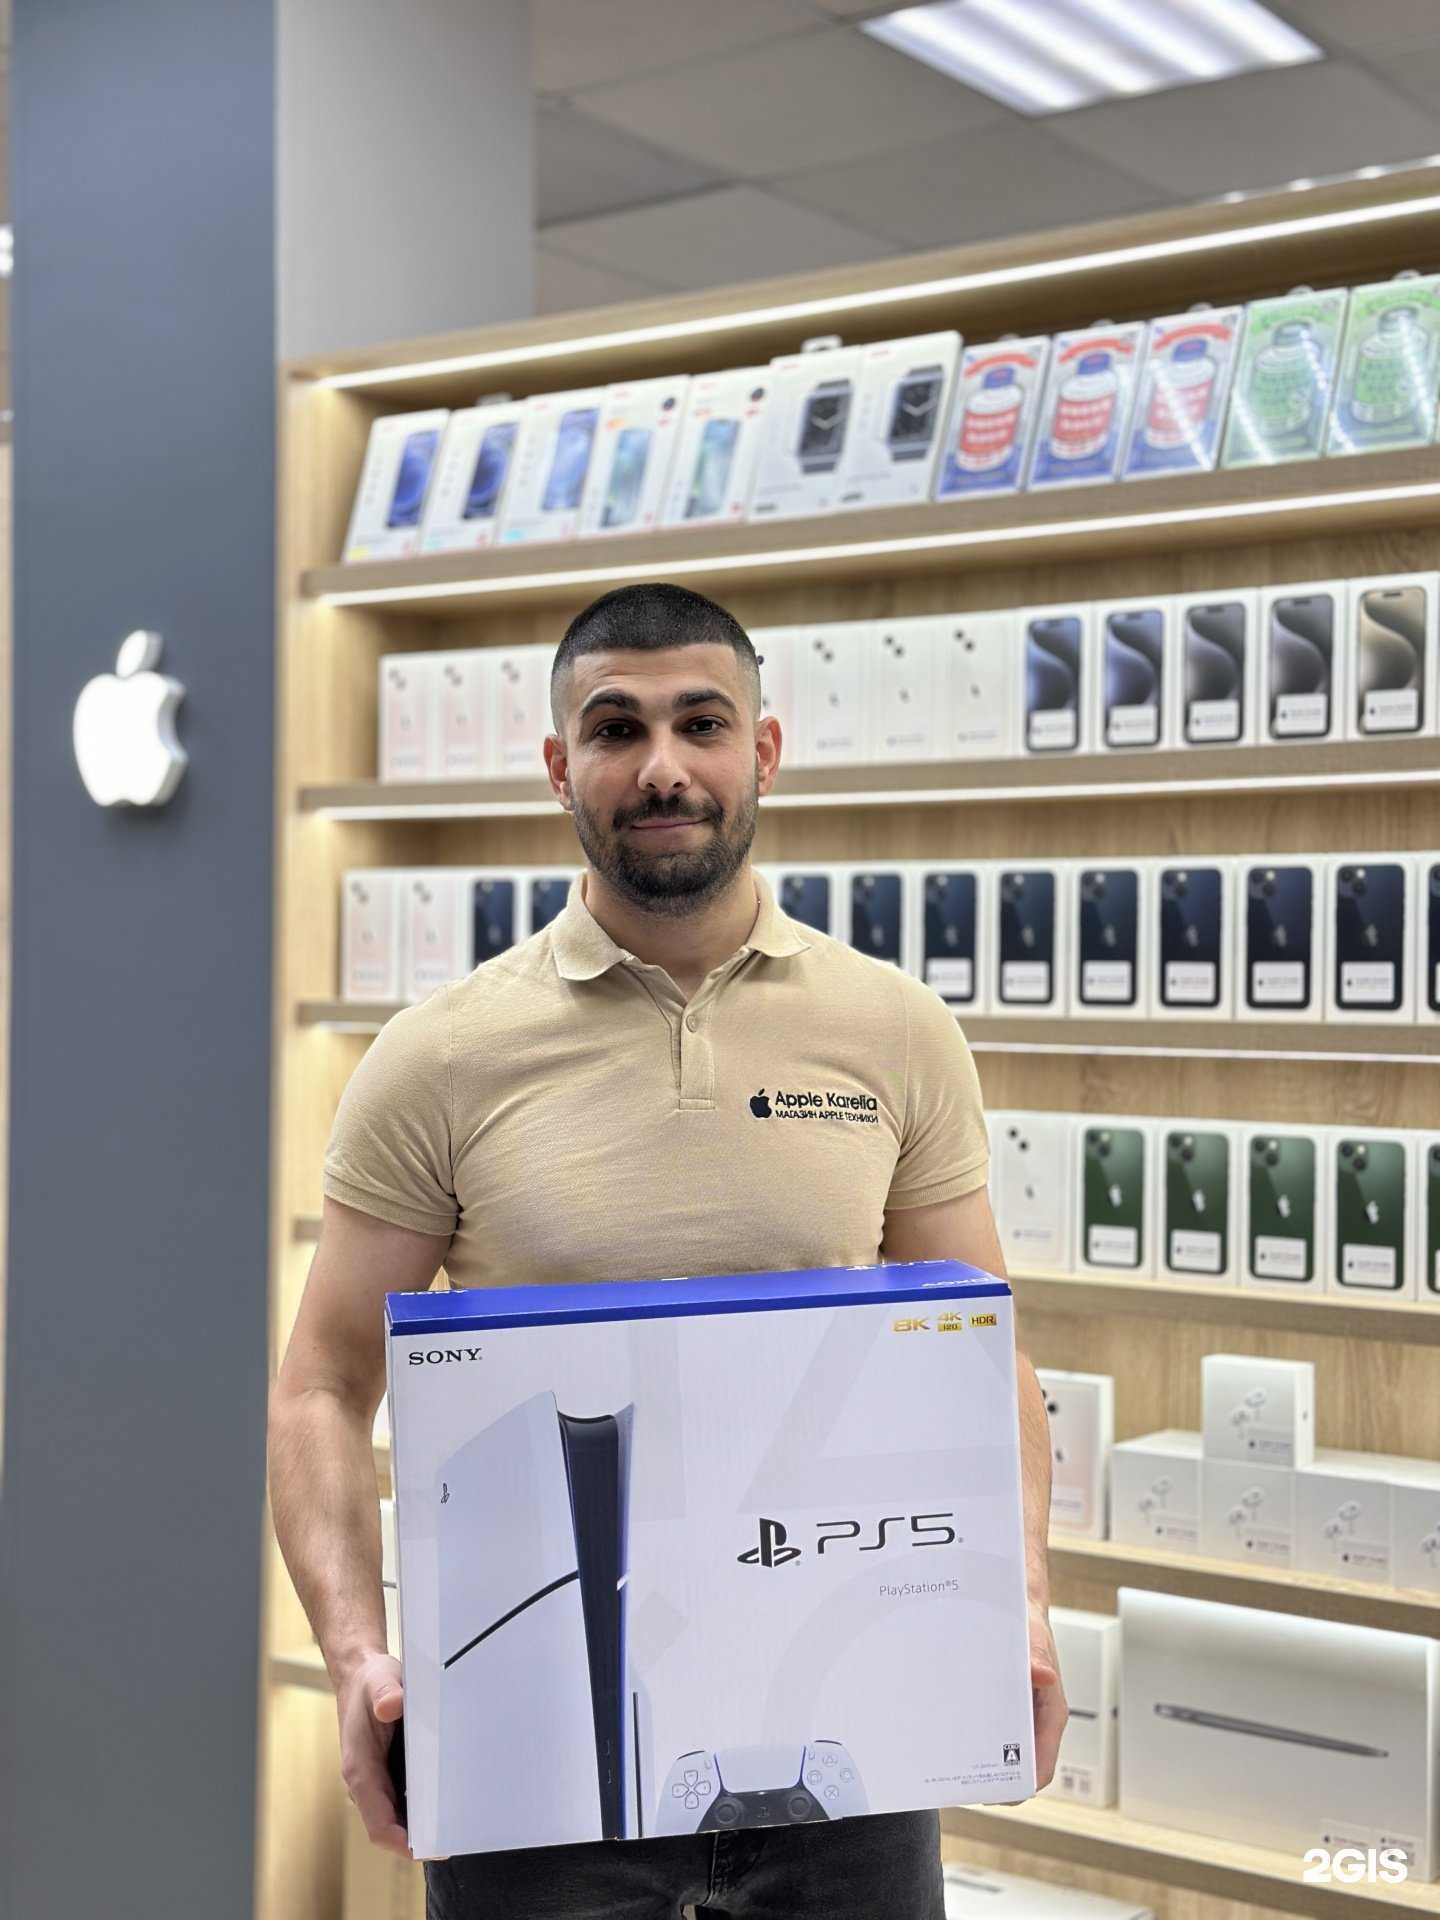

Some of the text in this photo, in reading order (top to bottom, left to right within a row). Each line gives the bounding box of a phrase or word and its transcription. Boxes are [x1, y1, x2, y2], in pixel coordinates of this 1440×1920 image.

[775, 1090, 878, 1111] Apple Karelia
[775, 1109, 818, 1119] МАГАЗИН
[893, 1318, 930, 1333] 8K
[971, 1315, 995, 1326] HDR
[408, 1347, 482, 1366] SONY
[815, 1512, 957, 1555] PS5
